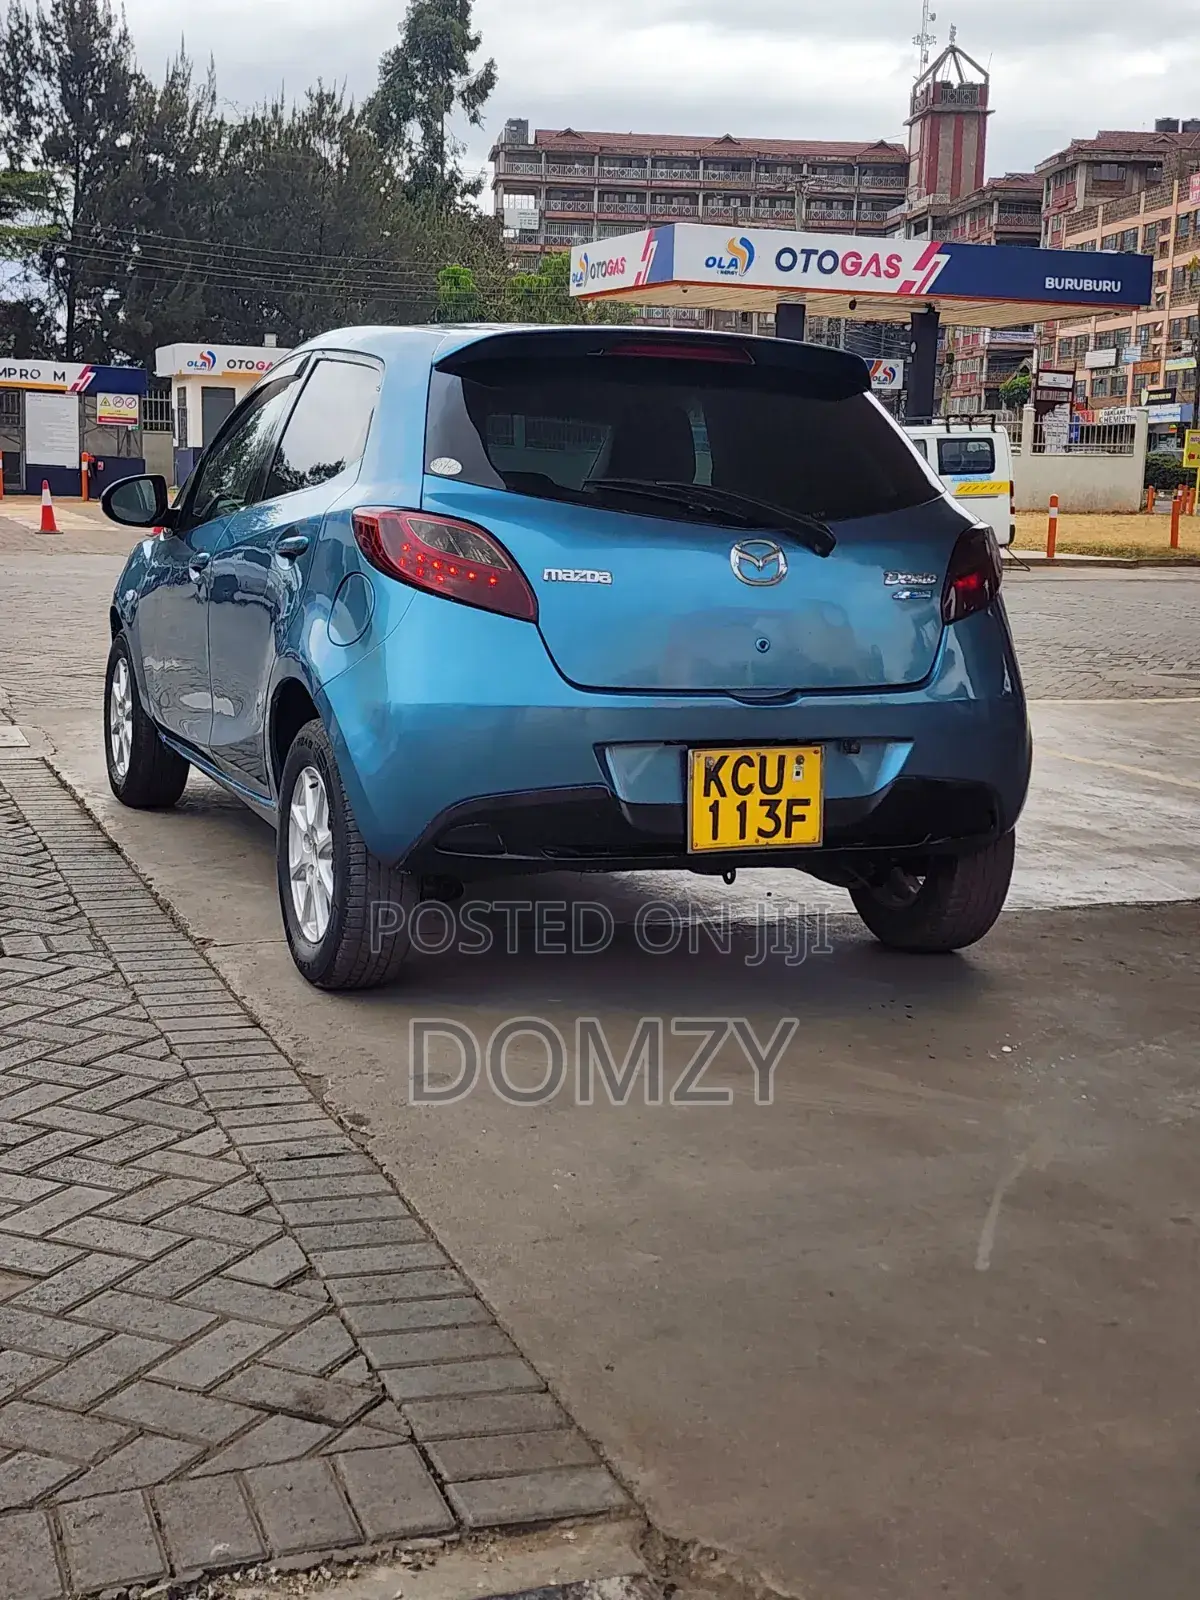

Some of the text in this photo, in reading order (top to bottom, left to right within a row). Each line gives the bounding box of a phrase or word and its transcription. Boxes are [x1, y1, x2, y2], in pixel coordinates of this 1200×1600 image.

[590, 256, 627, 280] OTOGAS
[705, 256, 738, 270] OLA
[775, 246, 903, 279] OTOGAS
[572, 271, 583, 283] OLA
[1044, 276, 1122, 293] BURUBURU
[187, 360, 207, 368] OLA
[226, 359, 274, 372] OTOGA
[53, 370, 66, 382] M
[543, 567, 613, 585] mazda
[703, 754, 787, 797] KCU
[708, 798, 811, 841] 113F
